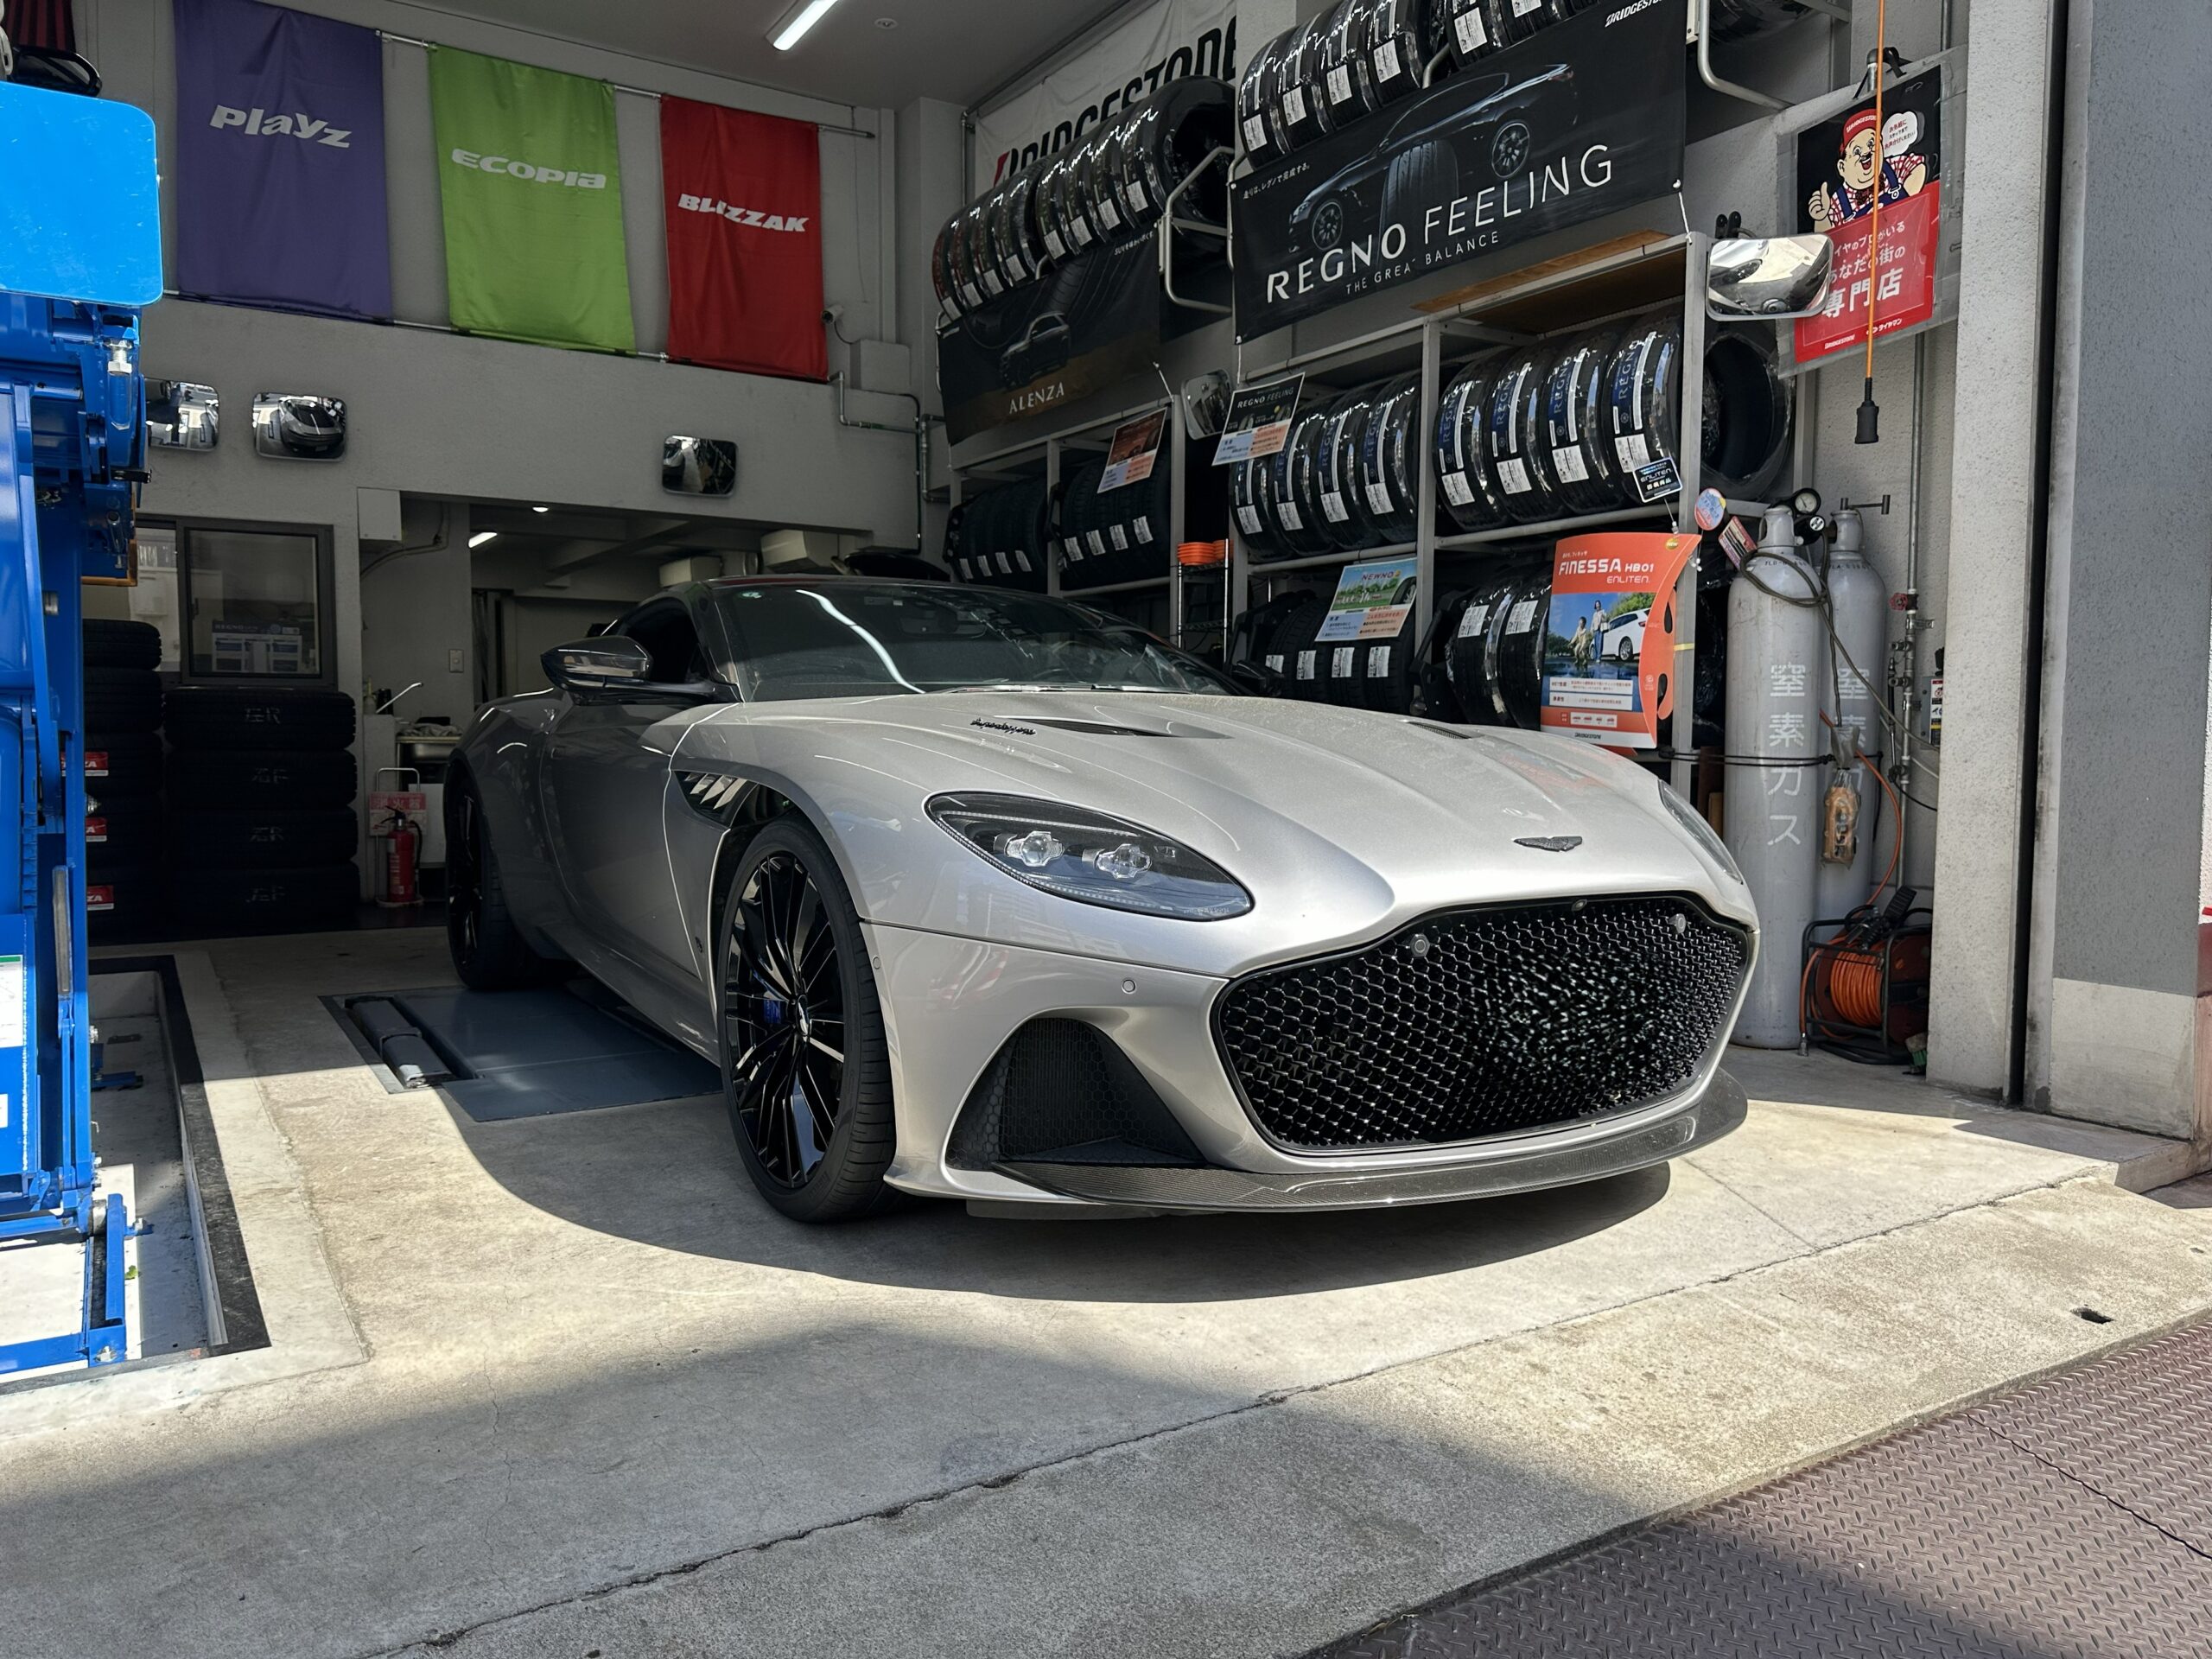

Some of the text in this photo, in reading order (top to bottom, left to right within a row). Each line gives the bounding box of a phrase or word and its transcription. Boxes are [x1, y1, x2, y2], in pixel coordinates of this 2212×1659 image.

[209, 105, 353, 148] Playz
[677, 193, 809, 232] BLIZZAK
[1267, 144, 1611, 303] REGNO FEELING
[1834, 221, 1905, 257] イヤのプロがいる
[1346, 231, 1499, 295] THE GREA BALANCE
[1821, 268, 1904, 318] 専門店
[1554, 356, 1572, 414] REGNO
[1618, 340, 1639, 399] REGNO
[1008, 382, 1065, 415] ALENZA
[1237, 396, 1265, 409] REGNO
[1267, 387, 1294, 401] FEELING
[1362, 571, 1394, 581] NEWNO
[1559, 558, 1654, 575] FINESSA HB01
